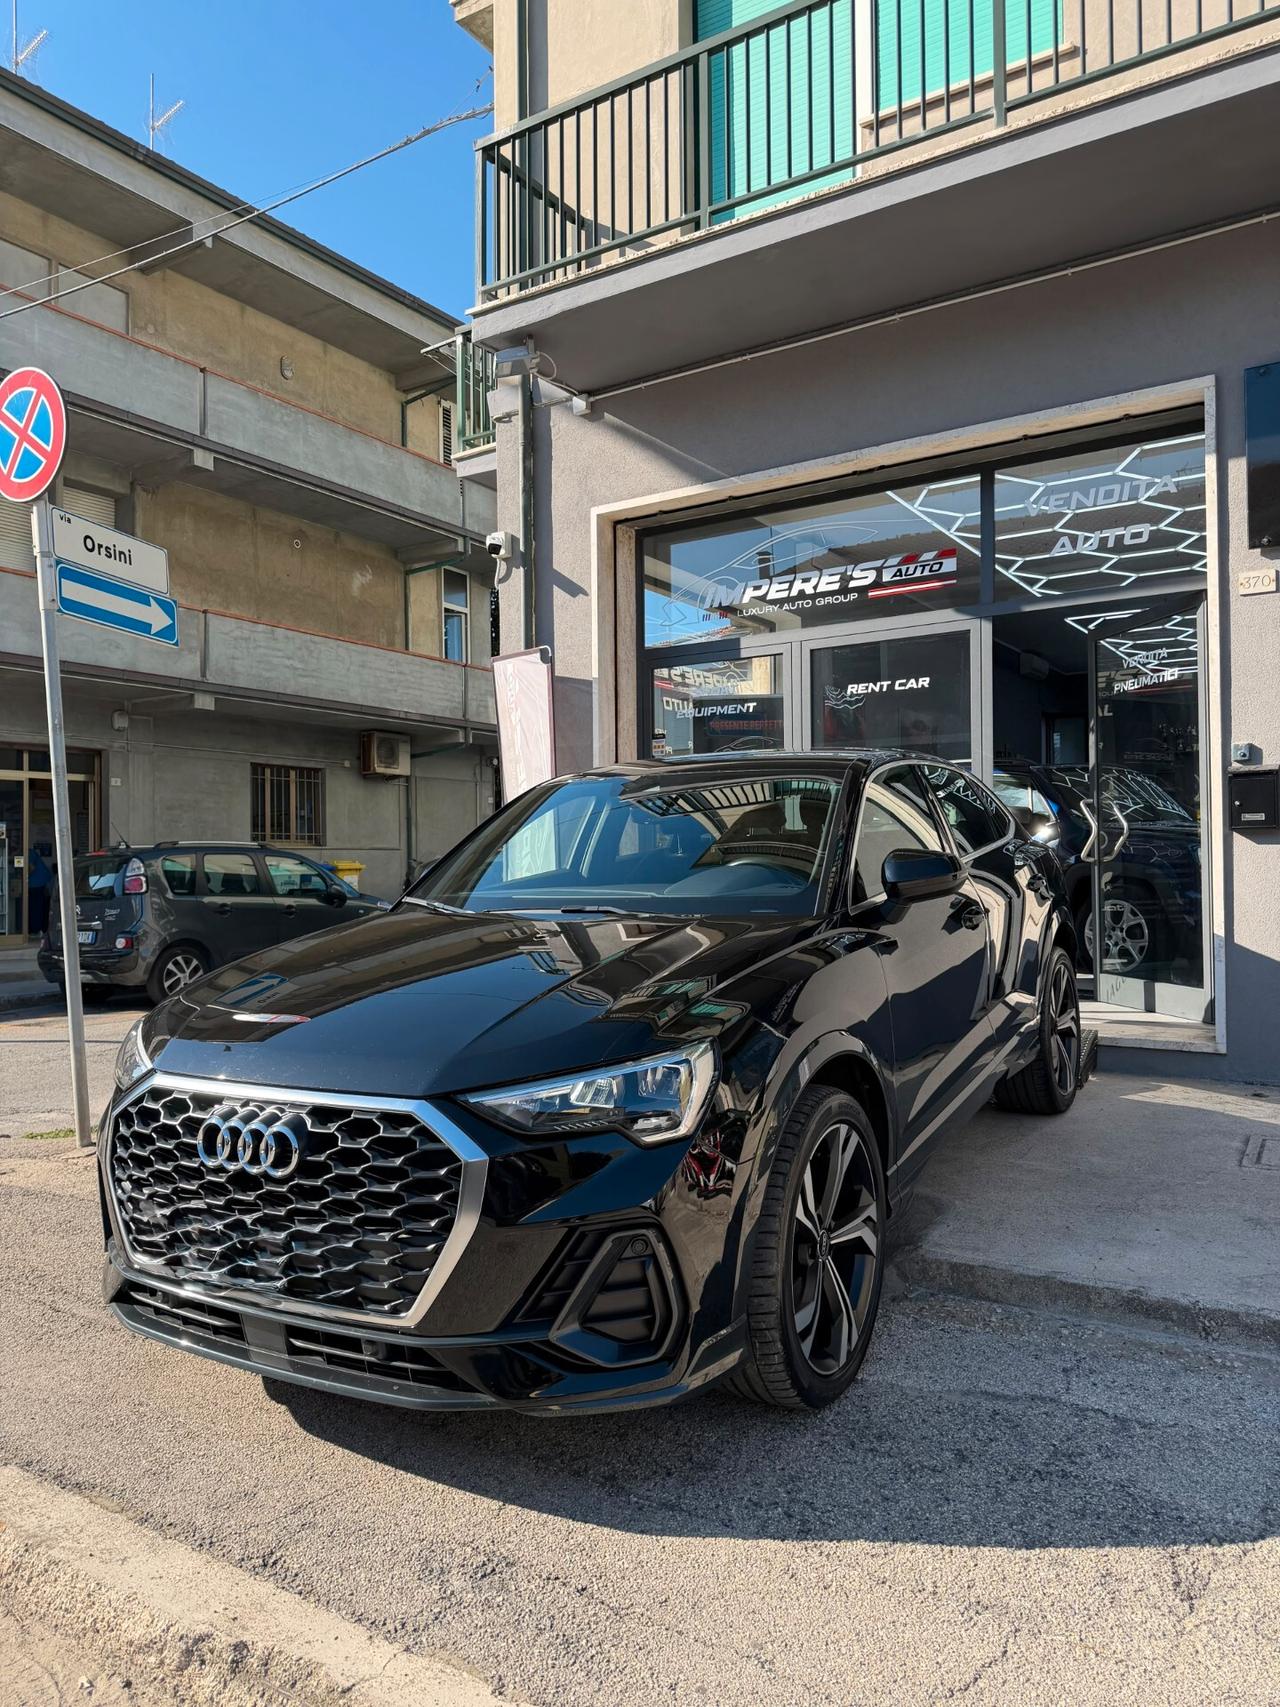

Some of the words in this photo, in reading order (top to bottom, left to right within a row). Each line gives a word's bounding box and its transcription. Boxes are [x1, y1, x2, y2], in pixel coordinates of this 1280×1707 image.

[1024, 475, 1178, 517] VENDITA
[59, 513, 72, 524] via
[83, 534, 132, 565] Orsini
[1051, 523, 1150, 555] AUTO
[703, 558, 884, 608] IMPERE'S
[890, 561, 944, 581] AUTO
[1243, 574, 1271, 589] 370
[737, 603, 780, 617] LUXURY
[783, 599, 812, 611] AUTO
[816, 592, 858, 606] GROUP
[846, 681, 891, 695] RENT
[894, 677, 930, 690] CAR
[676, 702, 757, 718] EQUIPMENT
